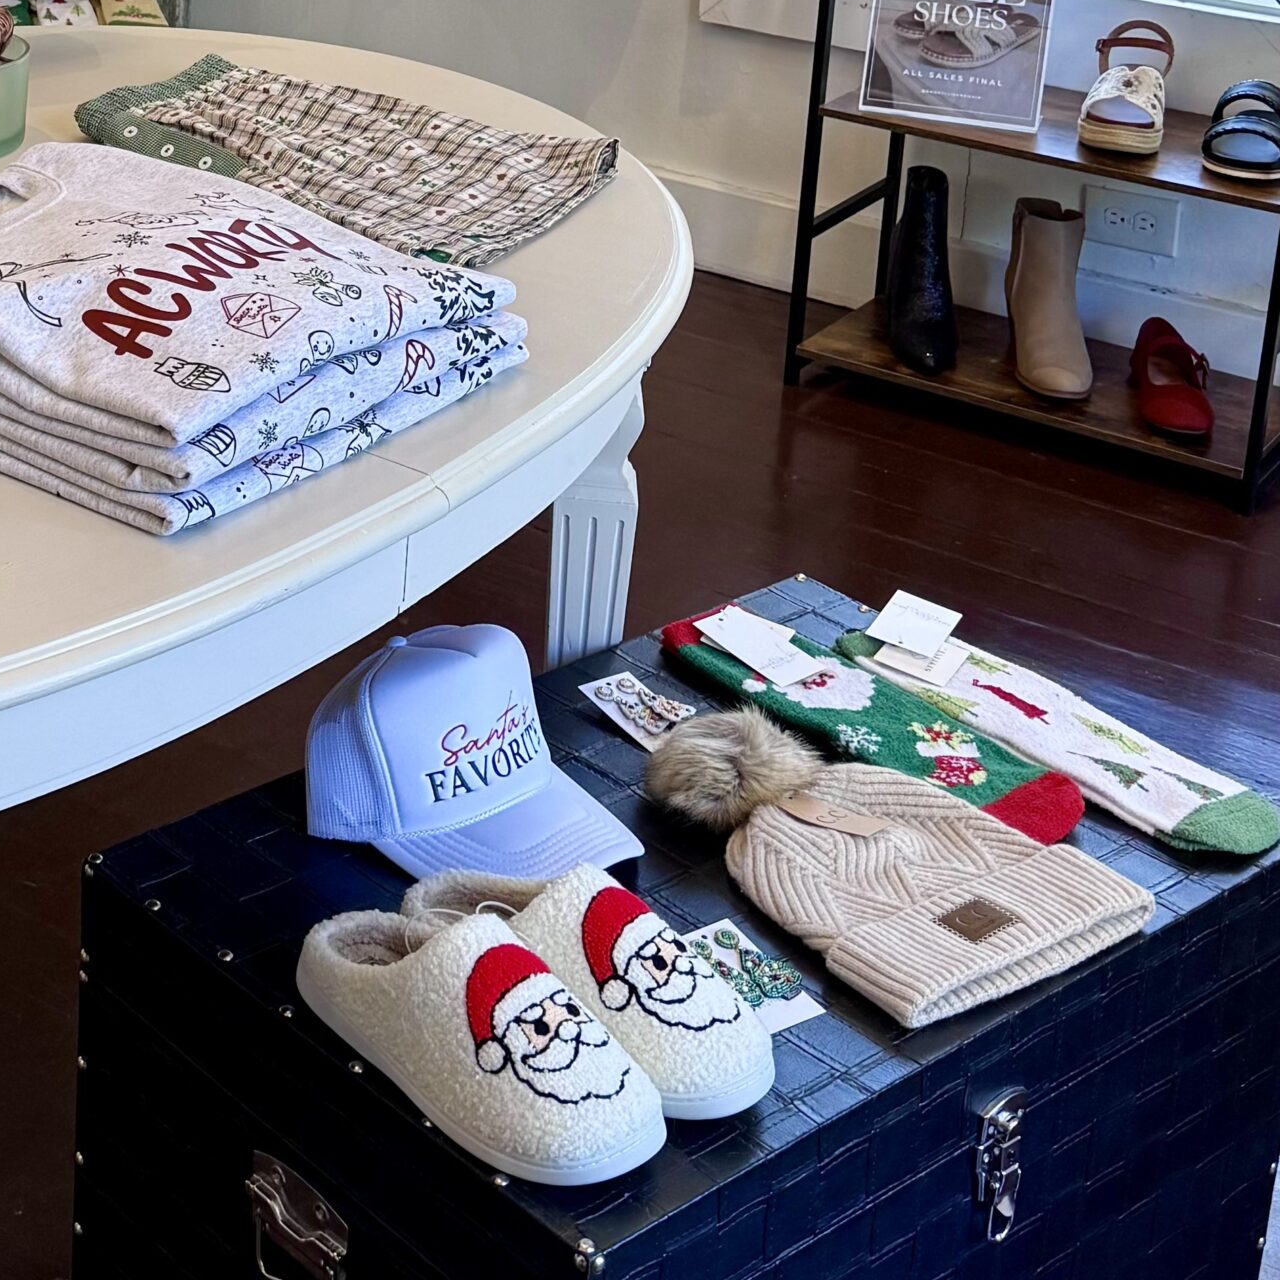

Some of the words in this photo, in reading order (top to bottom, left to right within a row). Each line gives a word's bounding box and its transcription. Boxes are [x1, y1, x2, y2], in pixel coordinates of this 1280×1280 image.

[913, 0, 1008, 31] SHOES
[902, 69, 924, 78] ALL
[928, 71, 964, 82] SALES
[969, 76, 1003, 87] FINAL
[425, 717, 541, 803] FAVORITE
